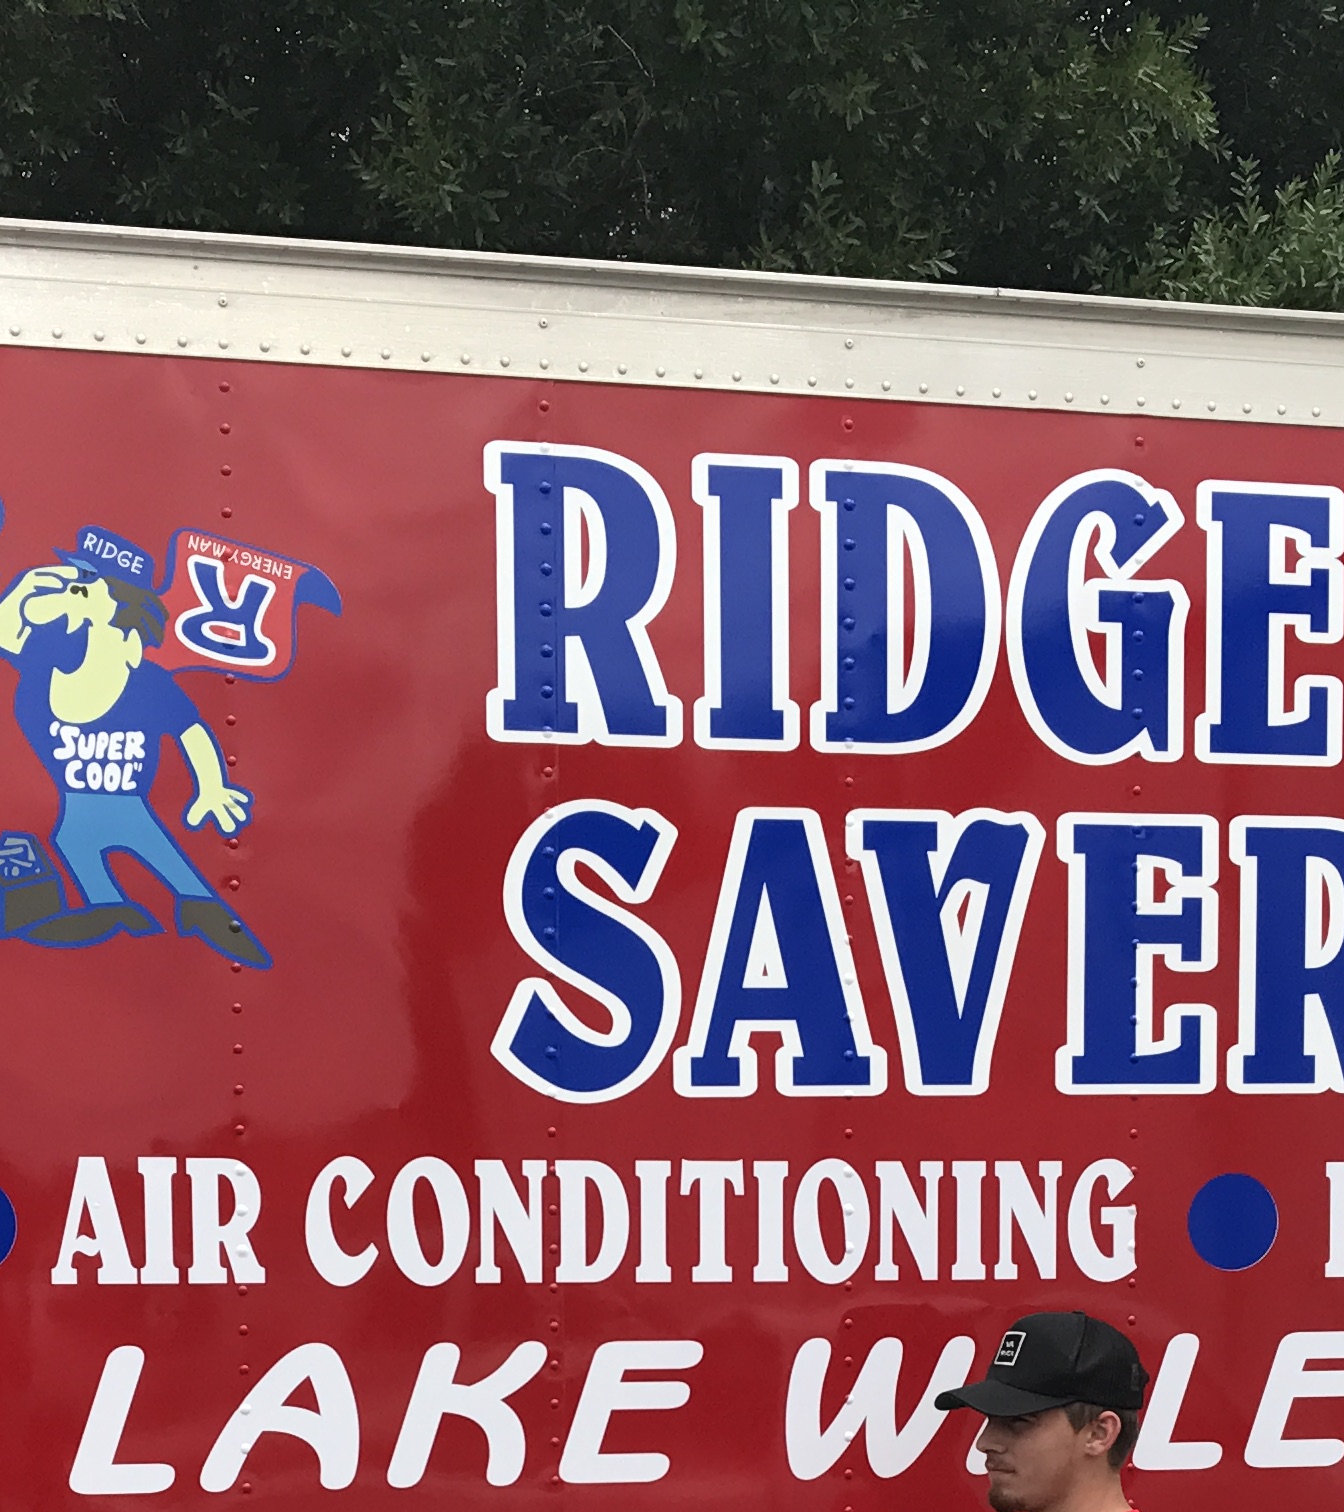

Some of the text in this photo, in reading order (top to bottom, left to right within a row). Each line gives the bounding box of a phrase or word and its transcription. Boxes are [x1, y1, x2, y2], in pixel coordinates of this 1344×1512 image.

[83, 532, 145, 576] RIDGE
[174, 554, 277, 667] R
[187, 534, 293, 580] ENERGY MAN
[483, 440, 1344, 767] RIDGE
[51, 1157, 265, 1284] AIR
[305, 1156, 1137, 1286] CONDITIONING
[69, 1340, 703, 1495] LAKE
